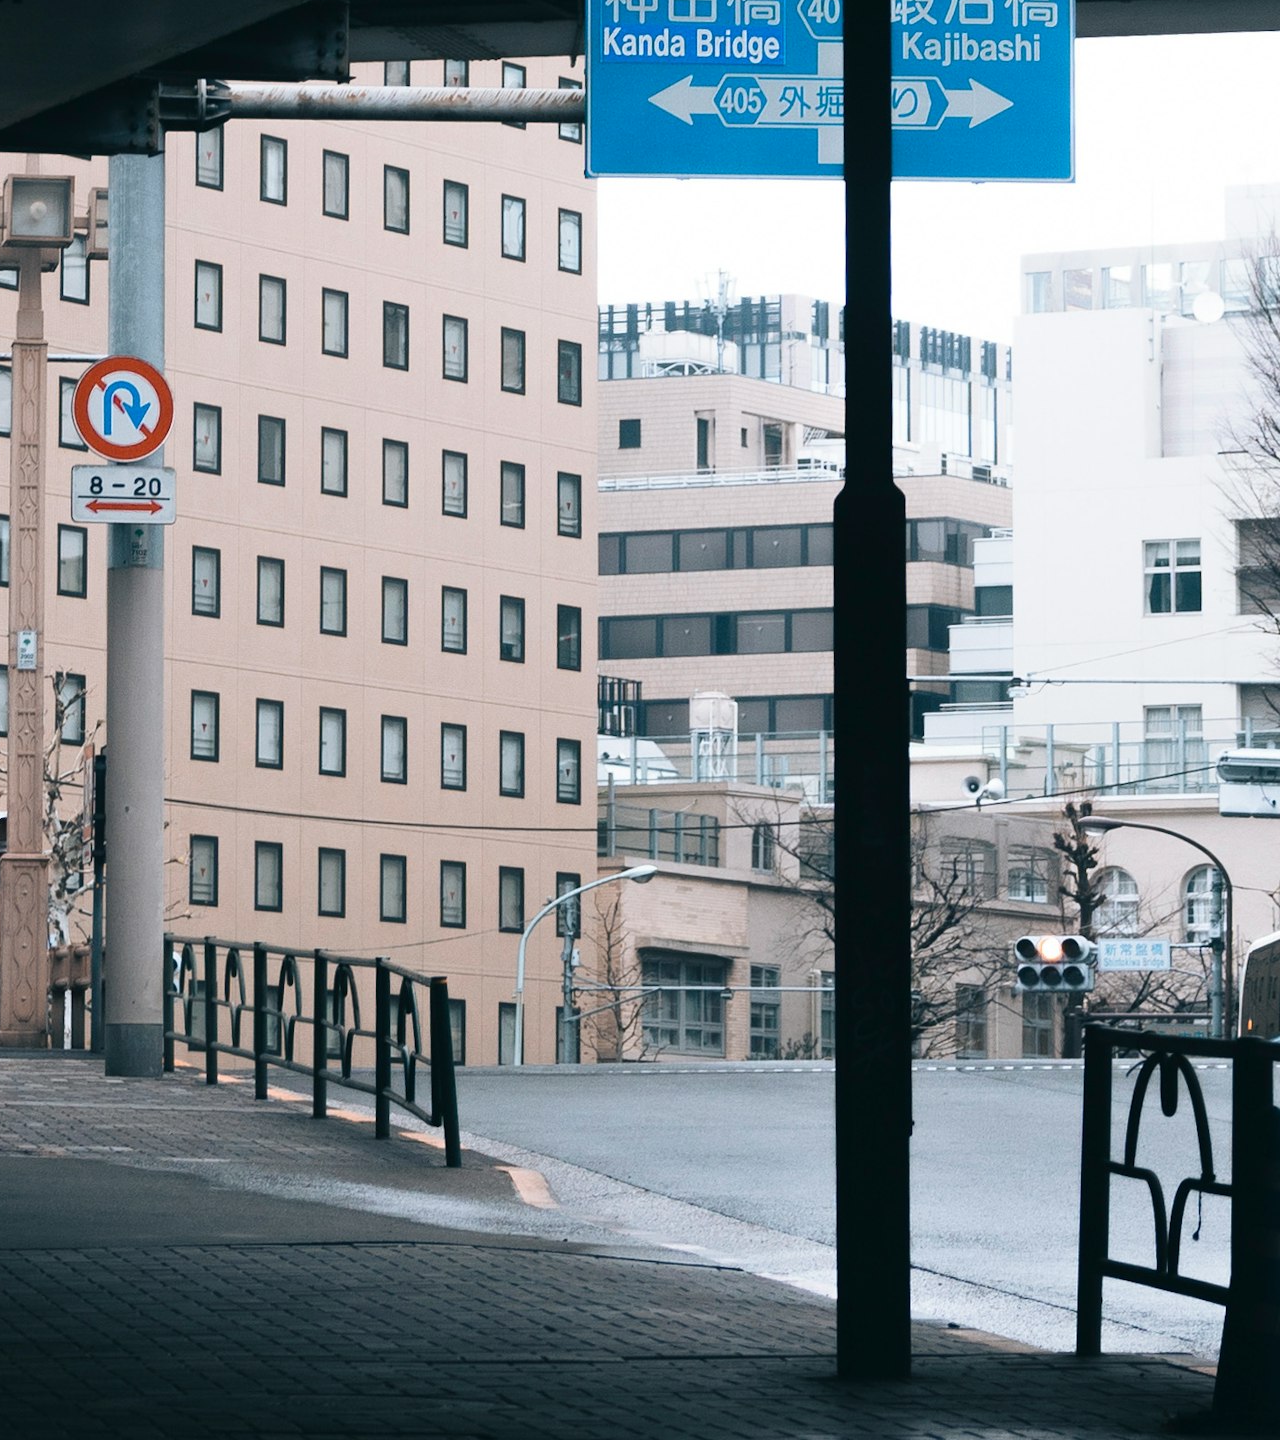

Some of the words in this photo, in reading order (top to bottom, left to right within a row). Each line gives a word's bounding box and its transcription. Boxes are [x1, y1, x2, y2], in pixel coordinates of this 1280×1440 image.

[603, 27, 685, 57] Kanda
[696, 28, 780, 64] Bridge
[902, 31, 1041, 67] Kajibashi
[720, 87, 761, 114] 405
[778, 85, 918, 118] 外堀り
